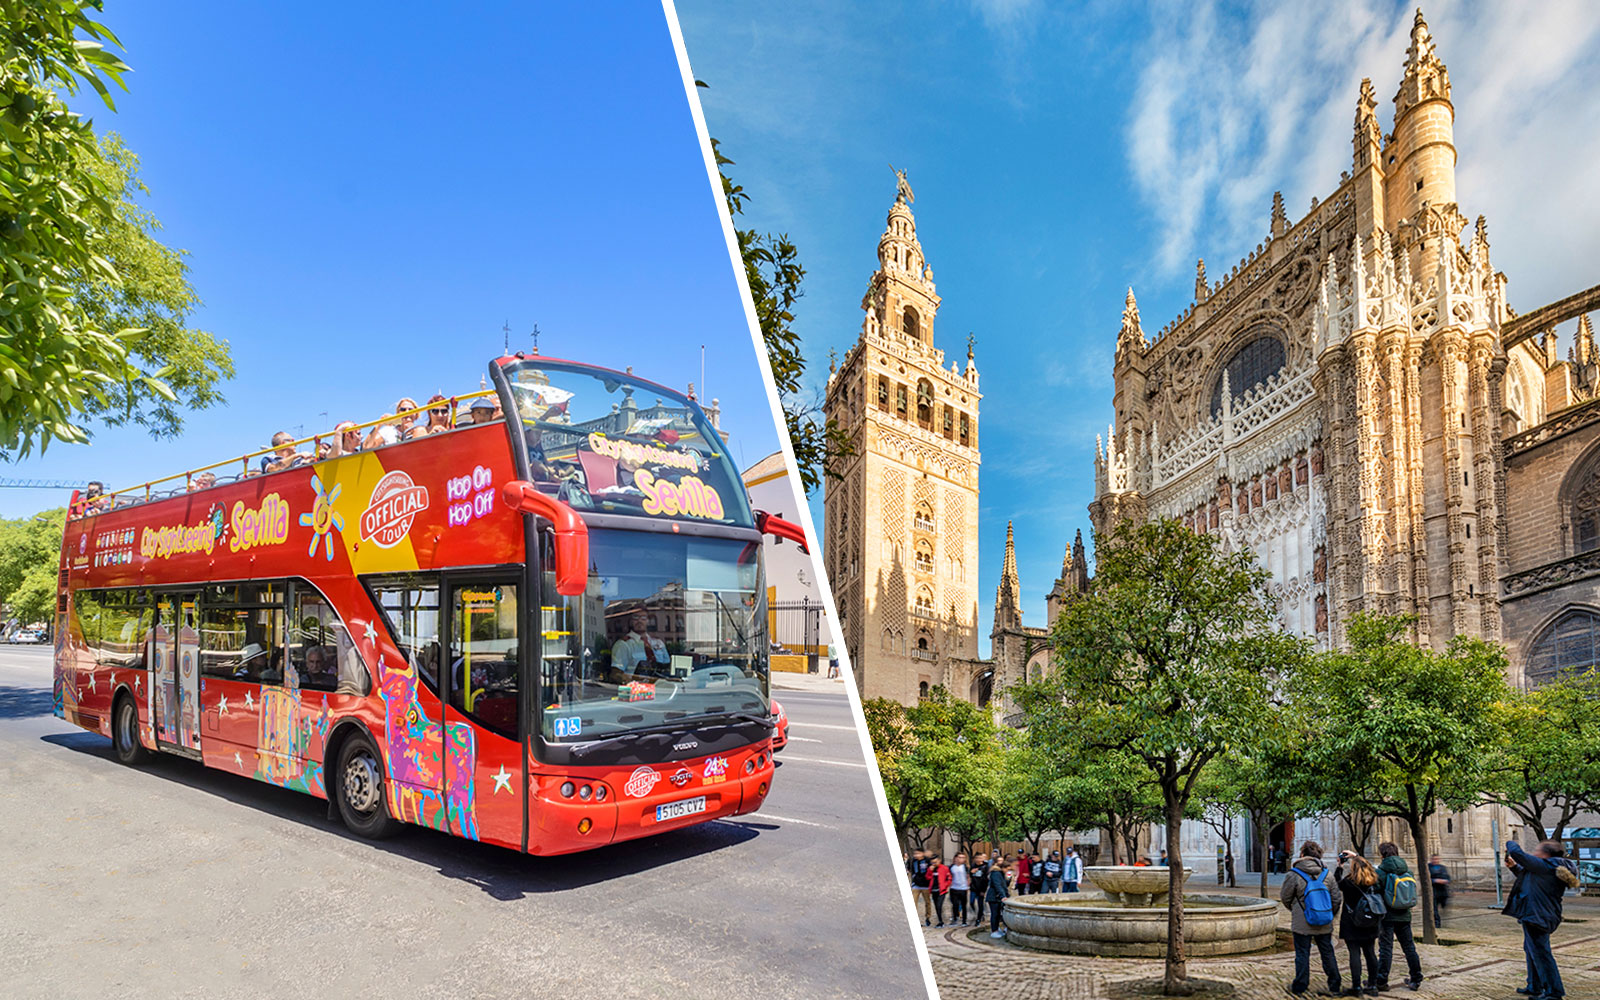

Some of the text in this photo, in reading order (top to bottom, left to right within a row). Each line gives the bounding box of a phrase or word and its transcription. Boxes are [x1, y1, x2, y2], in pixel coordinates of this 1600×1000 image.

[589, 433, 620, 459] City
[448, 466, 492, 500] Hop On
[634, 468, 724, 520] Sevilla
[366, 490, 424, 533] OFFICIAL
[449, 489, 495, 527] Hop Off
[230, 492, 289, 553] Sevilla
[382, 519, 408, 542] TOUR
[673, 742, 698, 750] VOLVO
[704, 757, 717, 777] 24
[628, 773, 659, 791] OFFICIAL
[663, 799, 704, 818] 5105 CVZ
